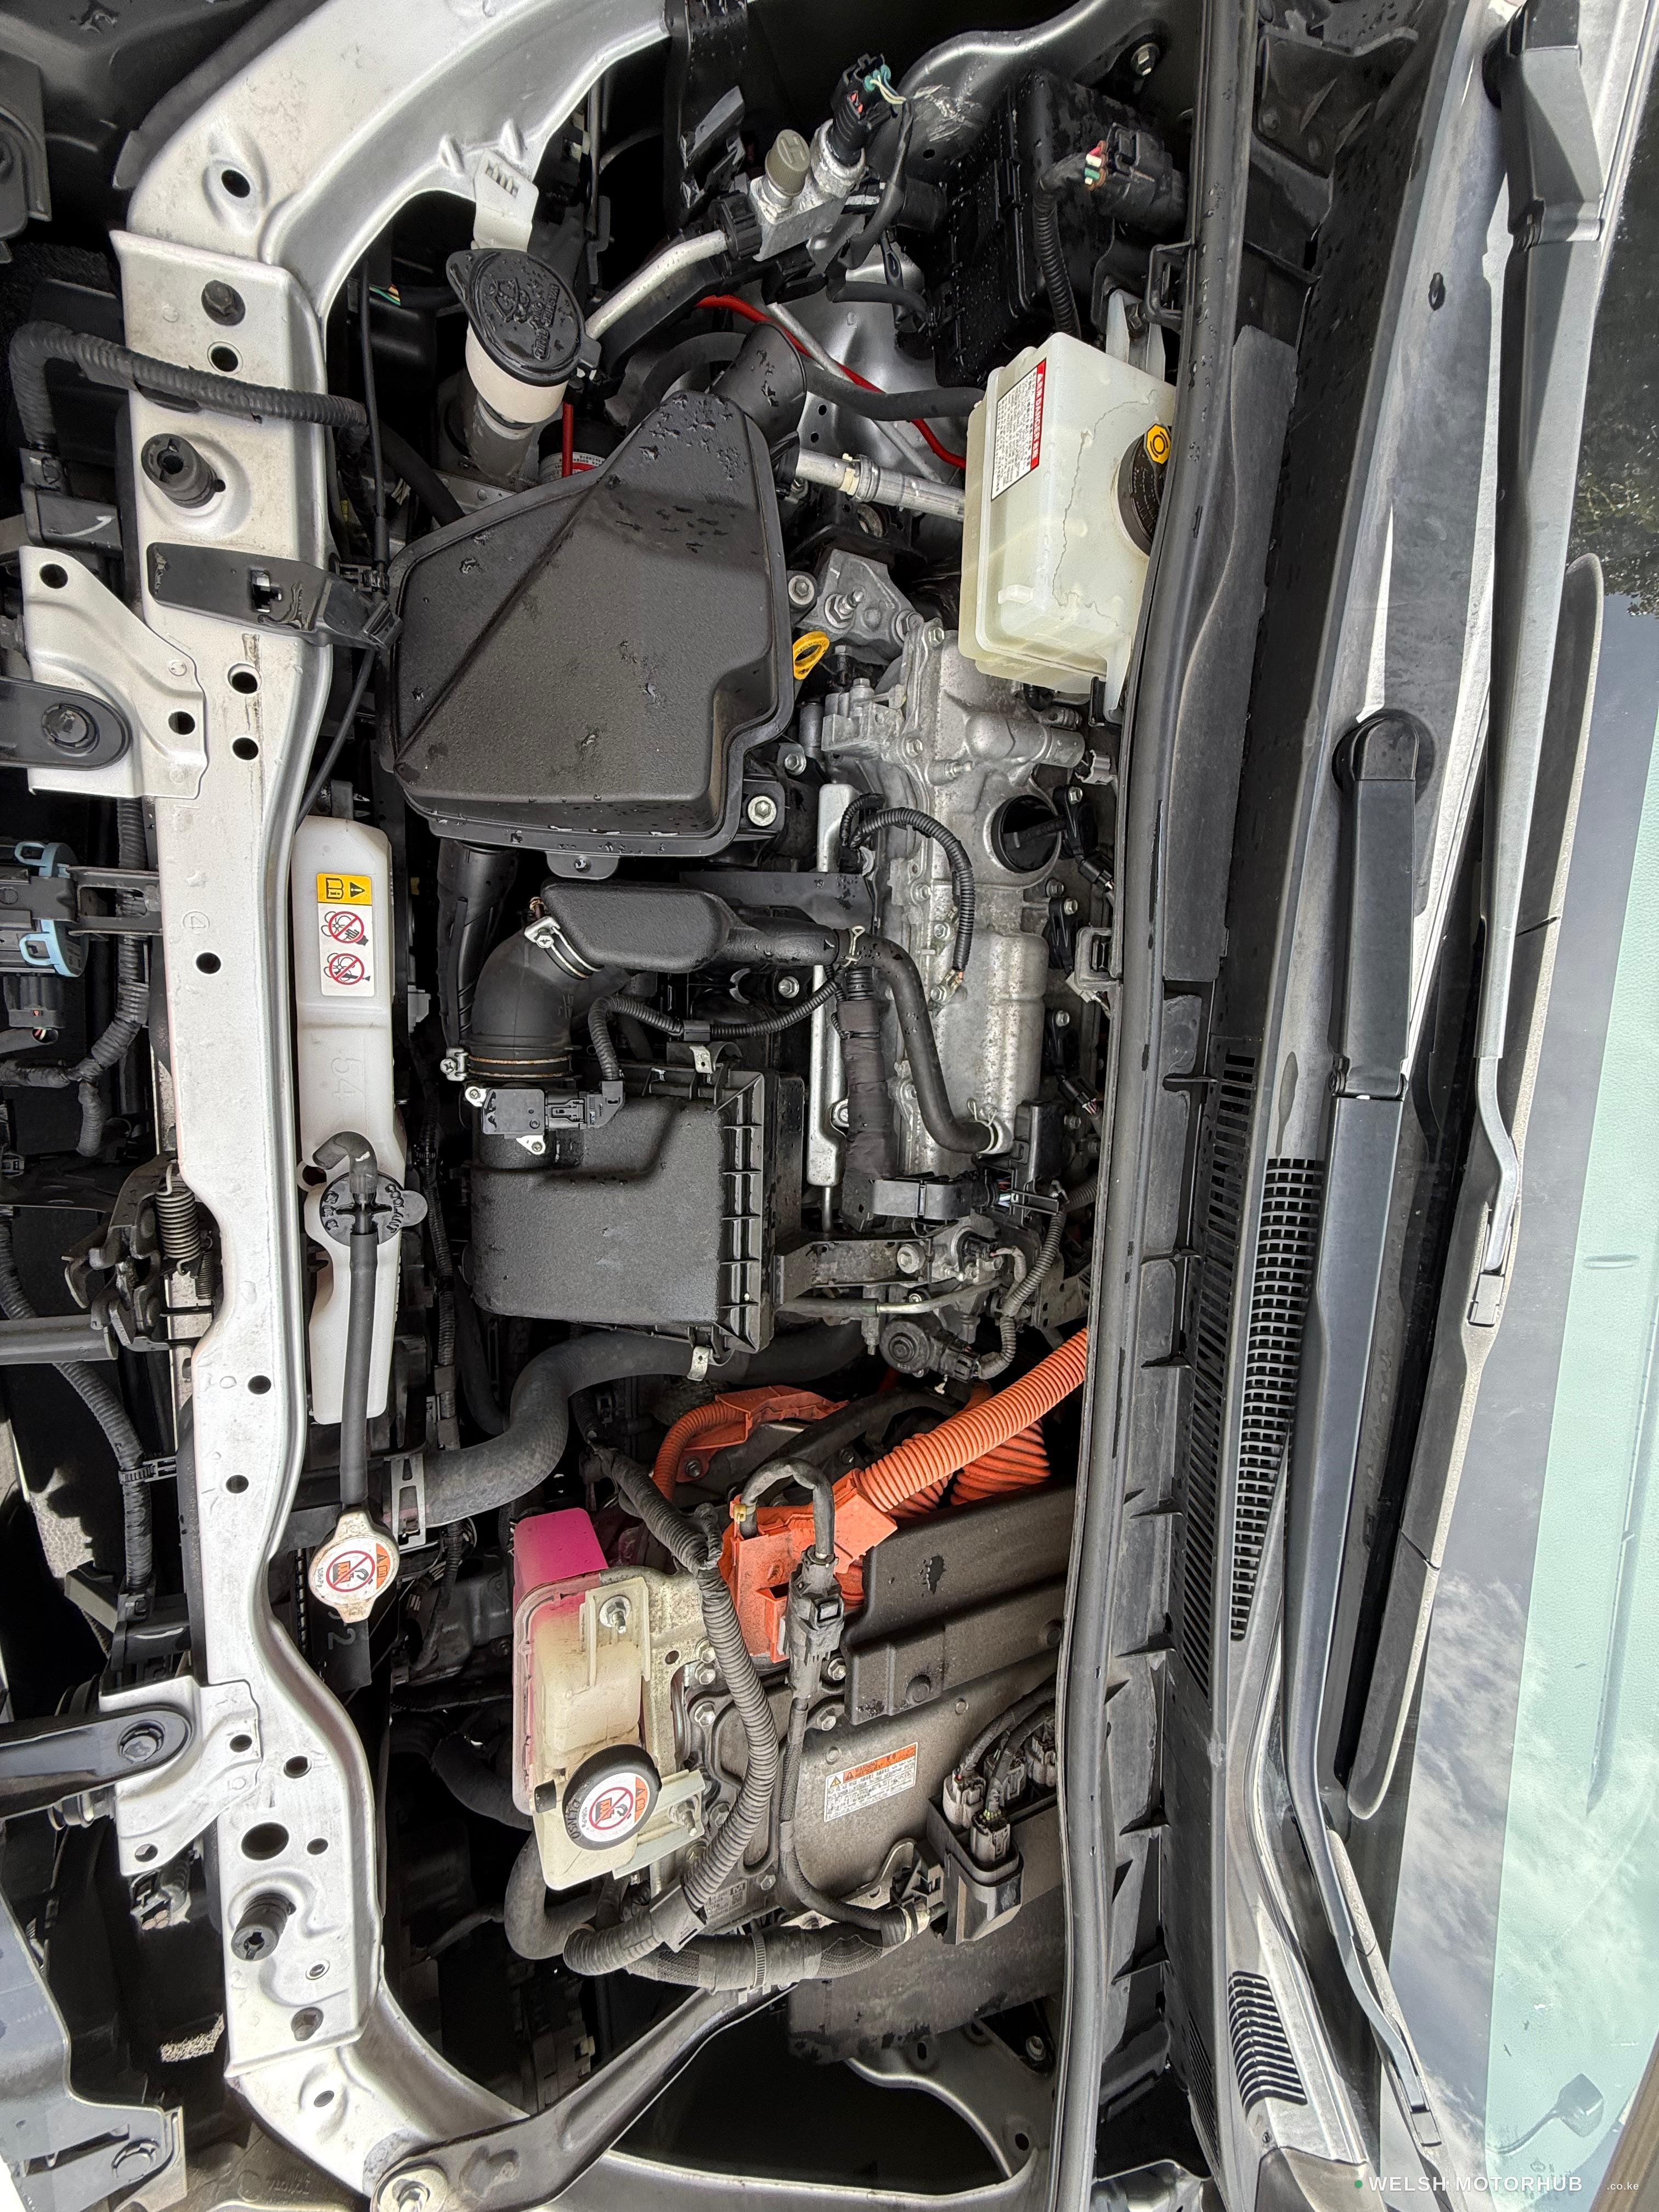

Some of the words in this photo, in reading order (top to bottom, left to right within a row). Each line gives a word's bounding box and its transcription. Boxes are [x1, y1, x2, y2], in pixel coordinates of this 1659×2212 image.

[1034, 397, 1043, 442] DANGER
[330, 1057, 363, 1102] 54
[385, 1183, 405, 1234] COOLANT
[567, 1798, 581, 1839] DENSO
